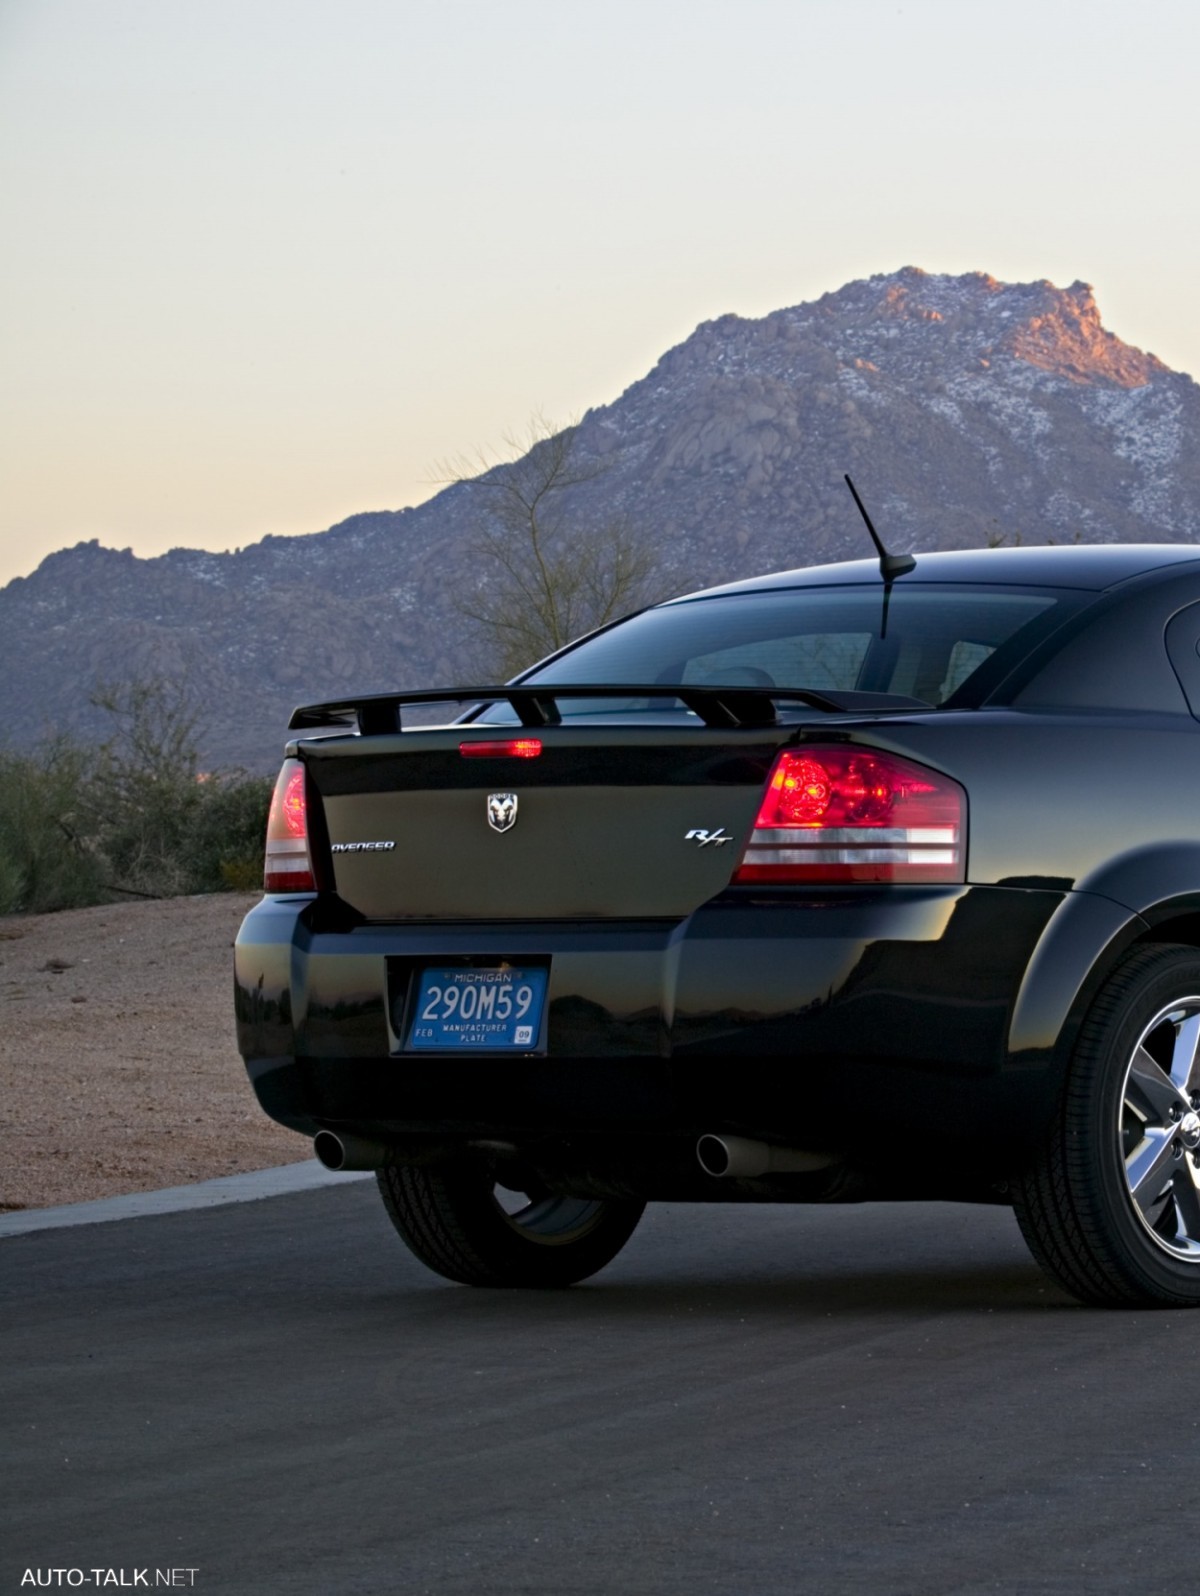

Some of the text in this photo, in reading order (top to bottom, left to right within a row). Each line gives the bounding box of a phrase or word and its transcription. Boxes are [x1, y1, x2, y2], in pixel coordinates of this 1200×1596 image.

[684, 827, 734, 847] R/T
[331, 841, 396, 852] AVENGER
[454, 973, 512, 983] MICHIGAN
[422, 985, 533, 1020] 290M59
[415, 1028, 433, 1037] FEB
[443, 1024, 507, 1032] MANUFACTURER
[460, 1034, 486, 1042] PLATE
[518, 1030, 530, 1038] 09
